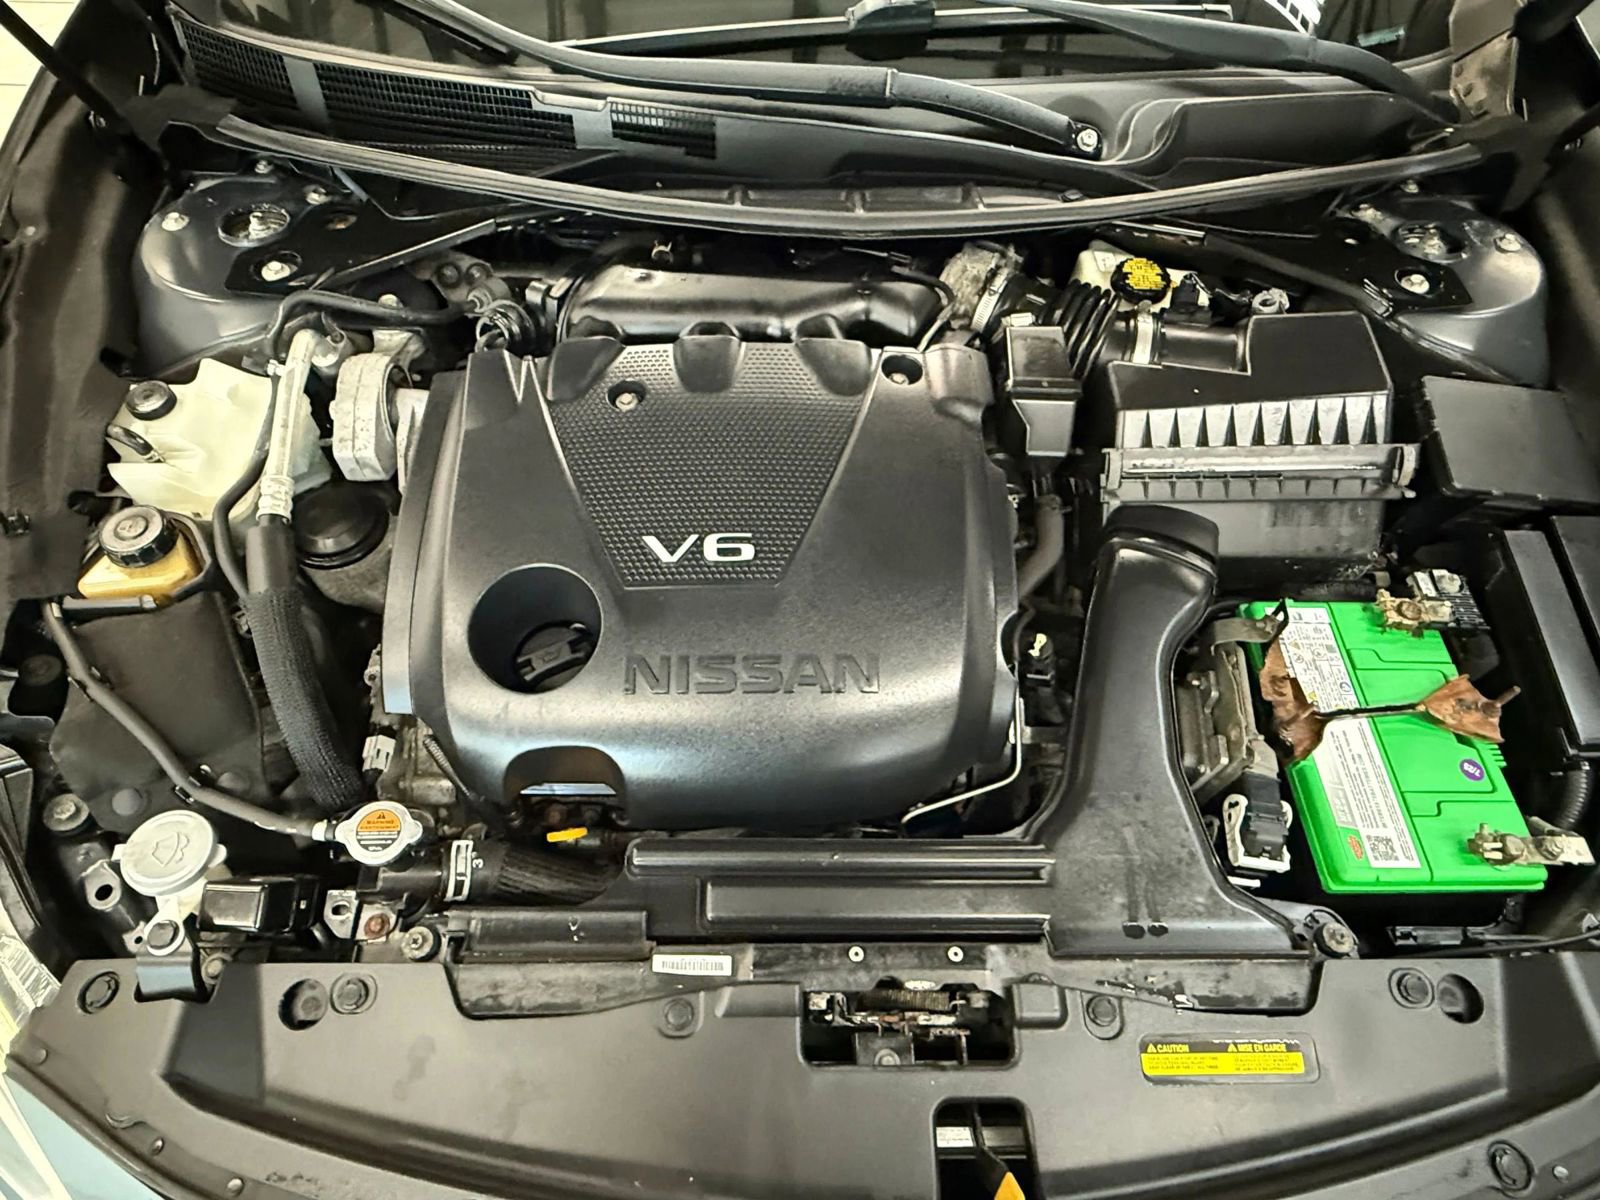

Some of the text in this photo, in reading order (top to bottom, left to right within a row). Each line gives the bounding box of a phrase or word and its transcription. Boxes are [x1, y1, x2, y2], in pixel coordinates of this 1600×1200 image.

[642, 533, 755, 562] V6
[624, 653, 880, 695] NISSAN
[1156, 1043, 1190, 1053] CAUTION
